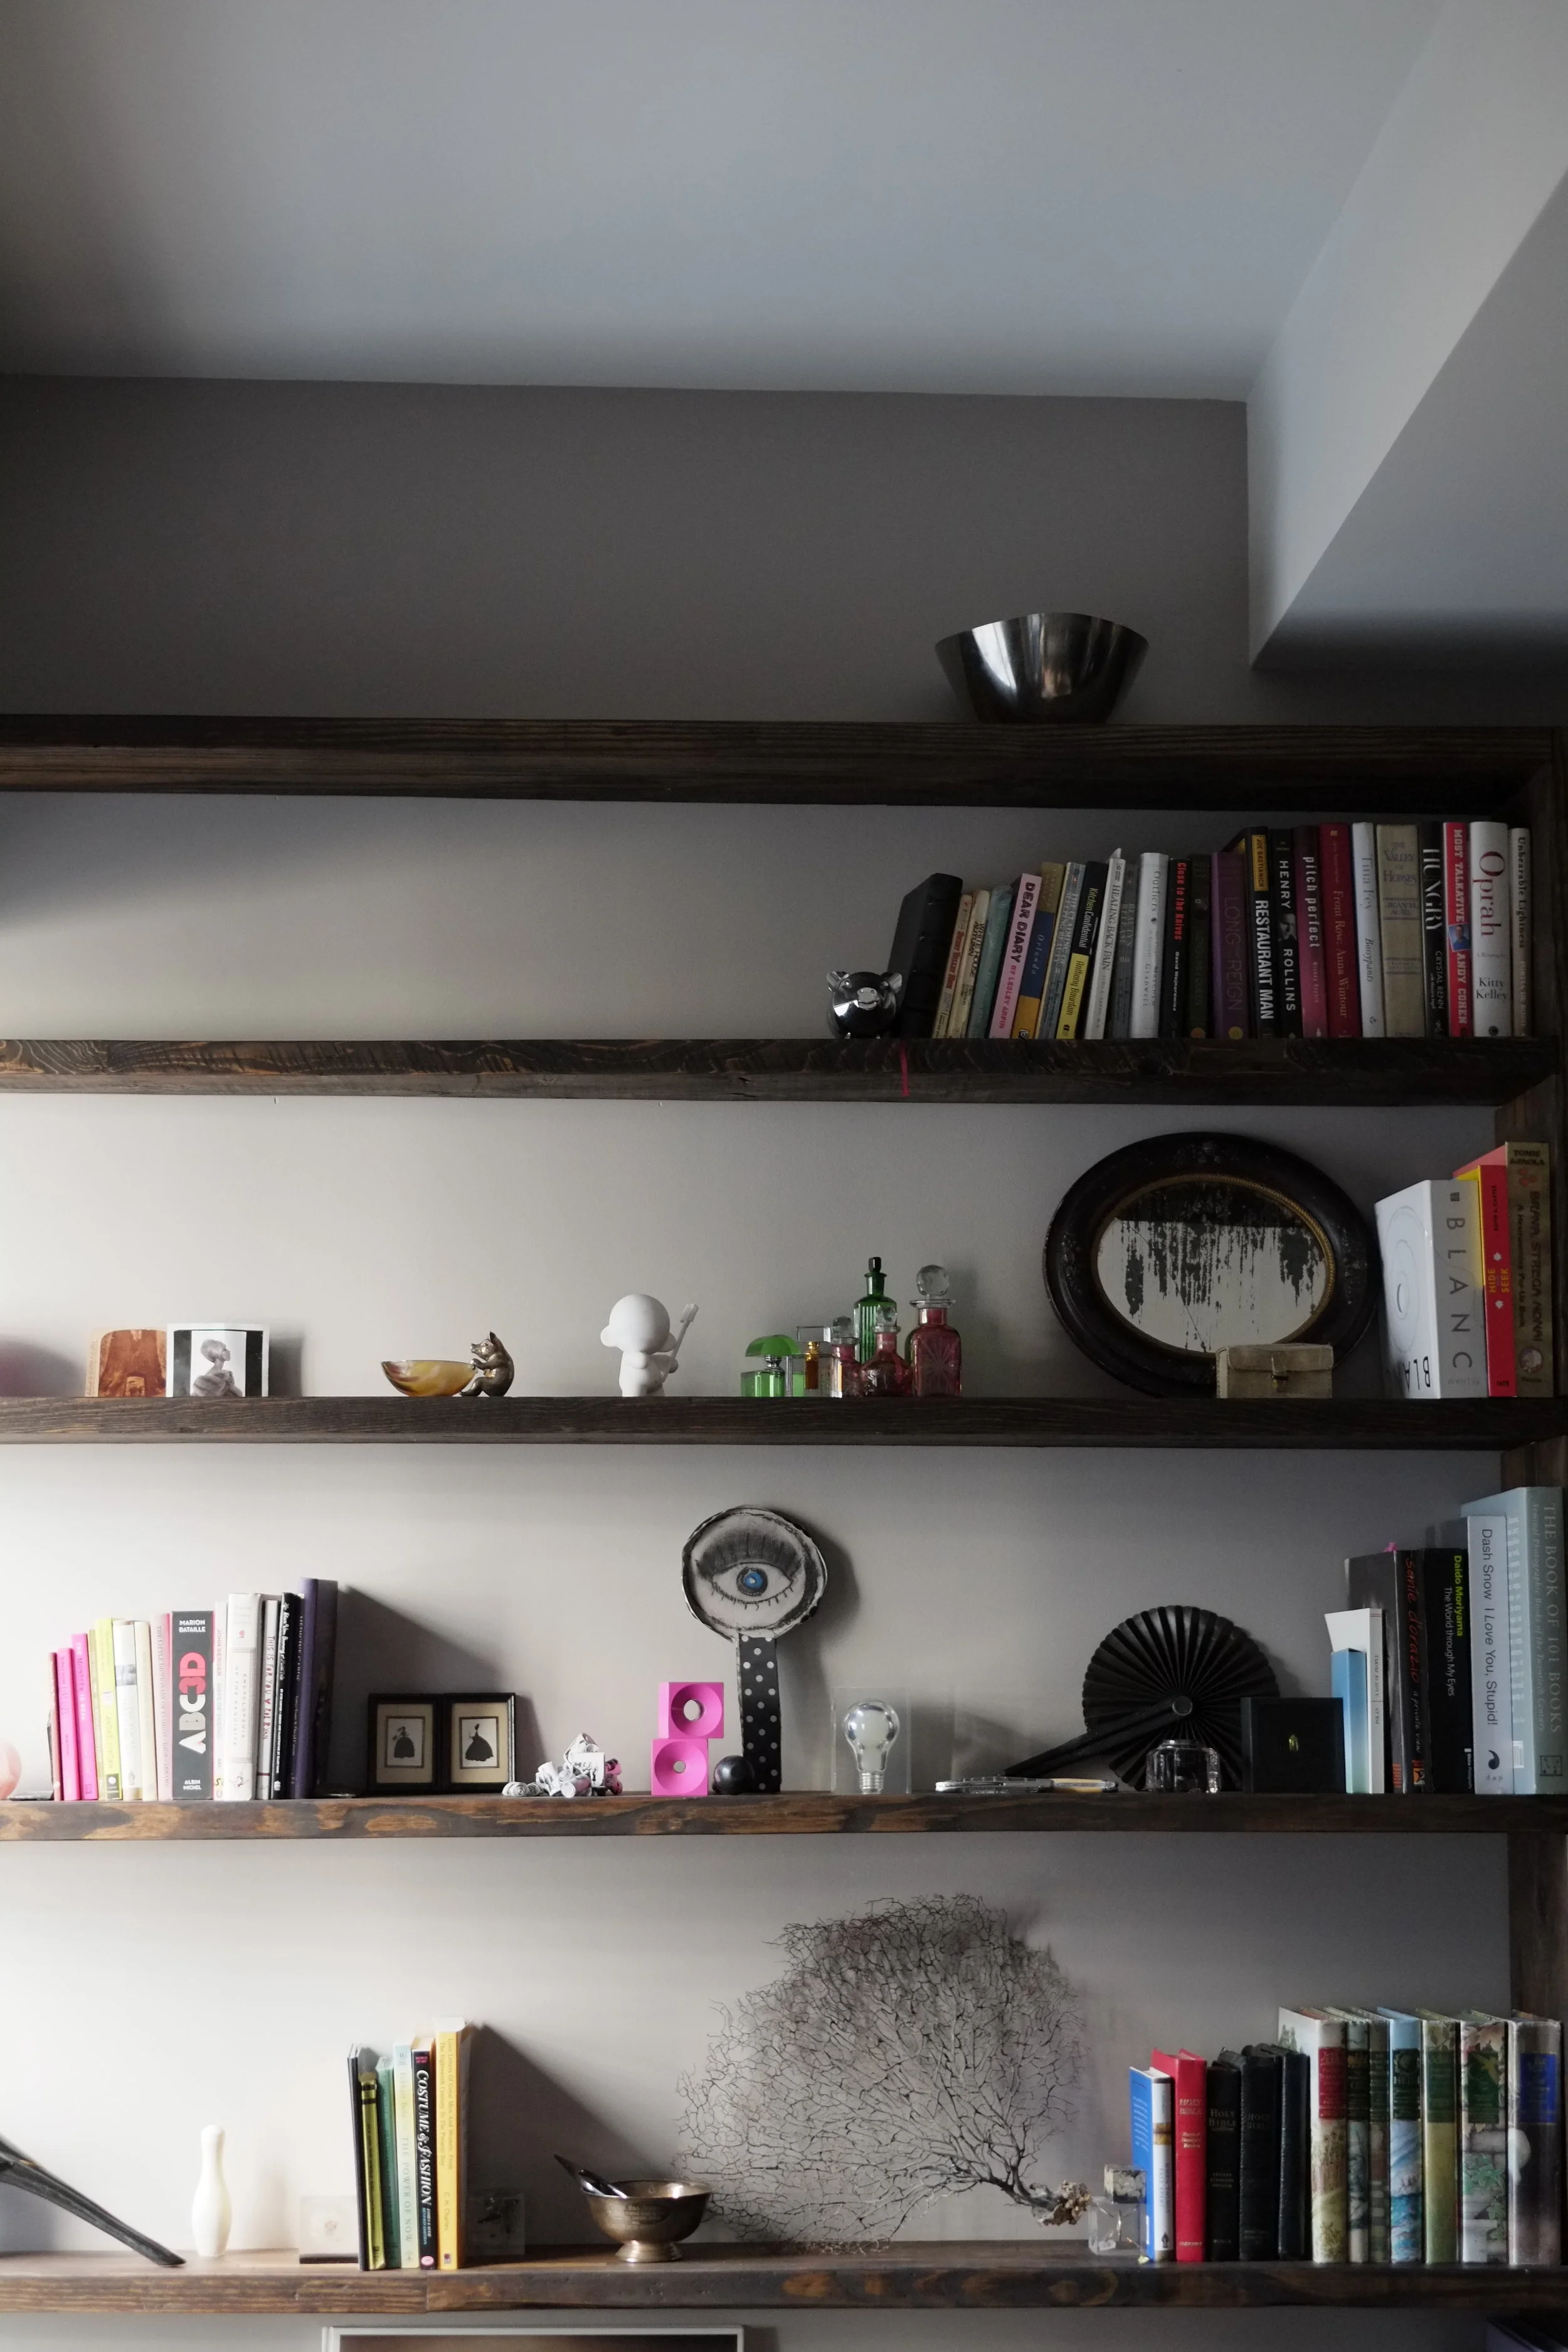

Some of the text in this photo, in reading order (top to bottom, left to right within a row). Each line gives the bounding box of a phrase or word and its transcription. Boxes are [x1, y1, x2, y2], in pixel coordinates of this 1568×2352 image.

[1150, 871, 1160, 911] Outliers
[1175, 862, 1187, 884] Close
[1278, 860, 1290, 908] HENRY
[1359, 855, 1375, 911] Tina Fey
[1422, 848, 1443, 933] HUNGRY
[1453, 829, 1465, 922] MOST TALKATIVE
[1515, 836, 1527, 948] Unbearable Lightness
[1107, 884, 1120, 923] HEALING
[1174, 898, 1185, 910] the
[1301, 856, 1321, 948] pitch perfect
[1333, 890, 1344, 917] Front
[1472, 850, 1505, 937] Oprah
[975, 923, 985, 949] WHITE
[1078, 887, 1098, 948] Kitchen Confidential
[1104, 926, 1115, 948] BACK
[1173, 913, 1184, 940] Knives
[1224, 896, 1241, 945] LONG
[968, 921, 979, 956] AUTUMN
[998, 882, 1036, 1029] DEAR DIARY BY LESLEY ARFIN
[1030, 934, 1045, 975] Orlando
[969, 950, 980, 978] HOUSE
[1101, 950, 1111, 970] PAIN
[1254, 899, 1273, 1019] RESTAURANT MAN
[1336, 948, 1347, 973] Anna
[1363, 938, 1375, 982] Bossypants
[1066, 960, 1084, 1015] Anthony Bourdain
[1226, 960, 1242, 1010] REIGN
[1282, 948, 1295, 1011] ROLLINS
[1337, 978, 1350, 1018] Wintour
[1456, 952, 1466, 1024] ANDY COHEN
[1476, 989, 1507, 1000] Kelley
[1479, 977, 1505, 990] Kitty
[1487, 1268, 1496, 1294] HIDE
[1500, 1268, 1510, 1293] SEEK
[1530, 1241, 1544, 1297] STREGA
[1446, 1216, 1472, 1369] BLANC
[1481, 1528, 1494, 1560] Dash
[1481, 1564, 1494, 1599] Snow
[1530, 1539, 1542, 1594] Photographic
[1453, 1555, 1465, 1636] Daido Moriyama
[1483, 1614, 1496, 1645] Love
[1543, 1502, 1562, 1733] THE BOOK OF 101 BOOKS
[267, 1635, 275, 1651] THIS
[1443, 1586, 1455, 1696] The World through My Eyes
[265, 1664, 273, 1677] FOR
[1482, 1648, 1496, 1676] You,
[1535, 1654, 1545, 1695] Twentieth
[264, 1680, 272, 1694] YOU
[1483, 1680, 1498, 1725] Stupid!
[1209, 2118, 1236, 2127] BIBLE
[1210, 2109, 1235, 2117] HOLY
[401, 2137, 409, 2157] THE
[416, 2069, 433, 2205] COSTUME & FASHION
[401, 2161, 411, 2198] POWER
[403, 2201, 411, 2215] OF
[404, 2218, 413, 2242] NOW
